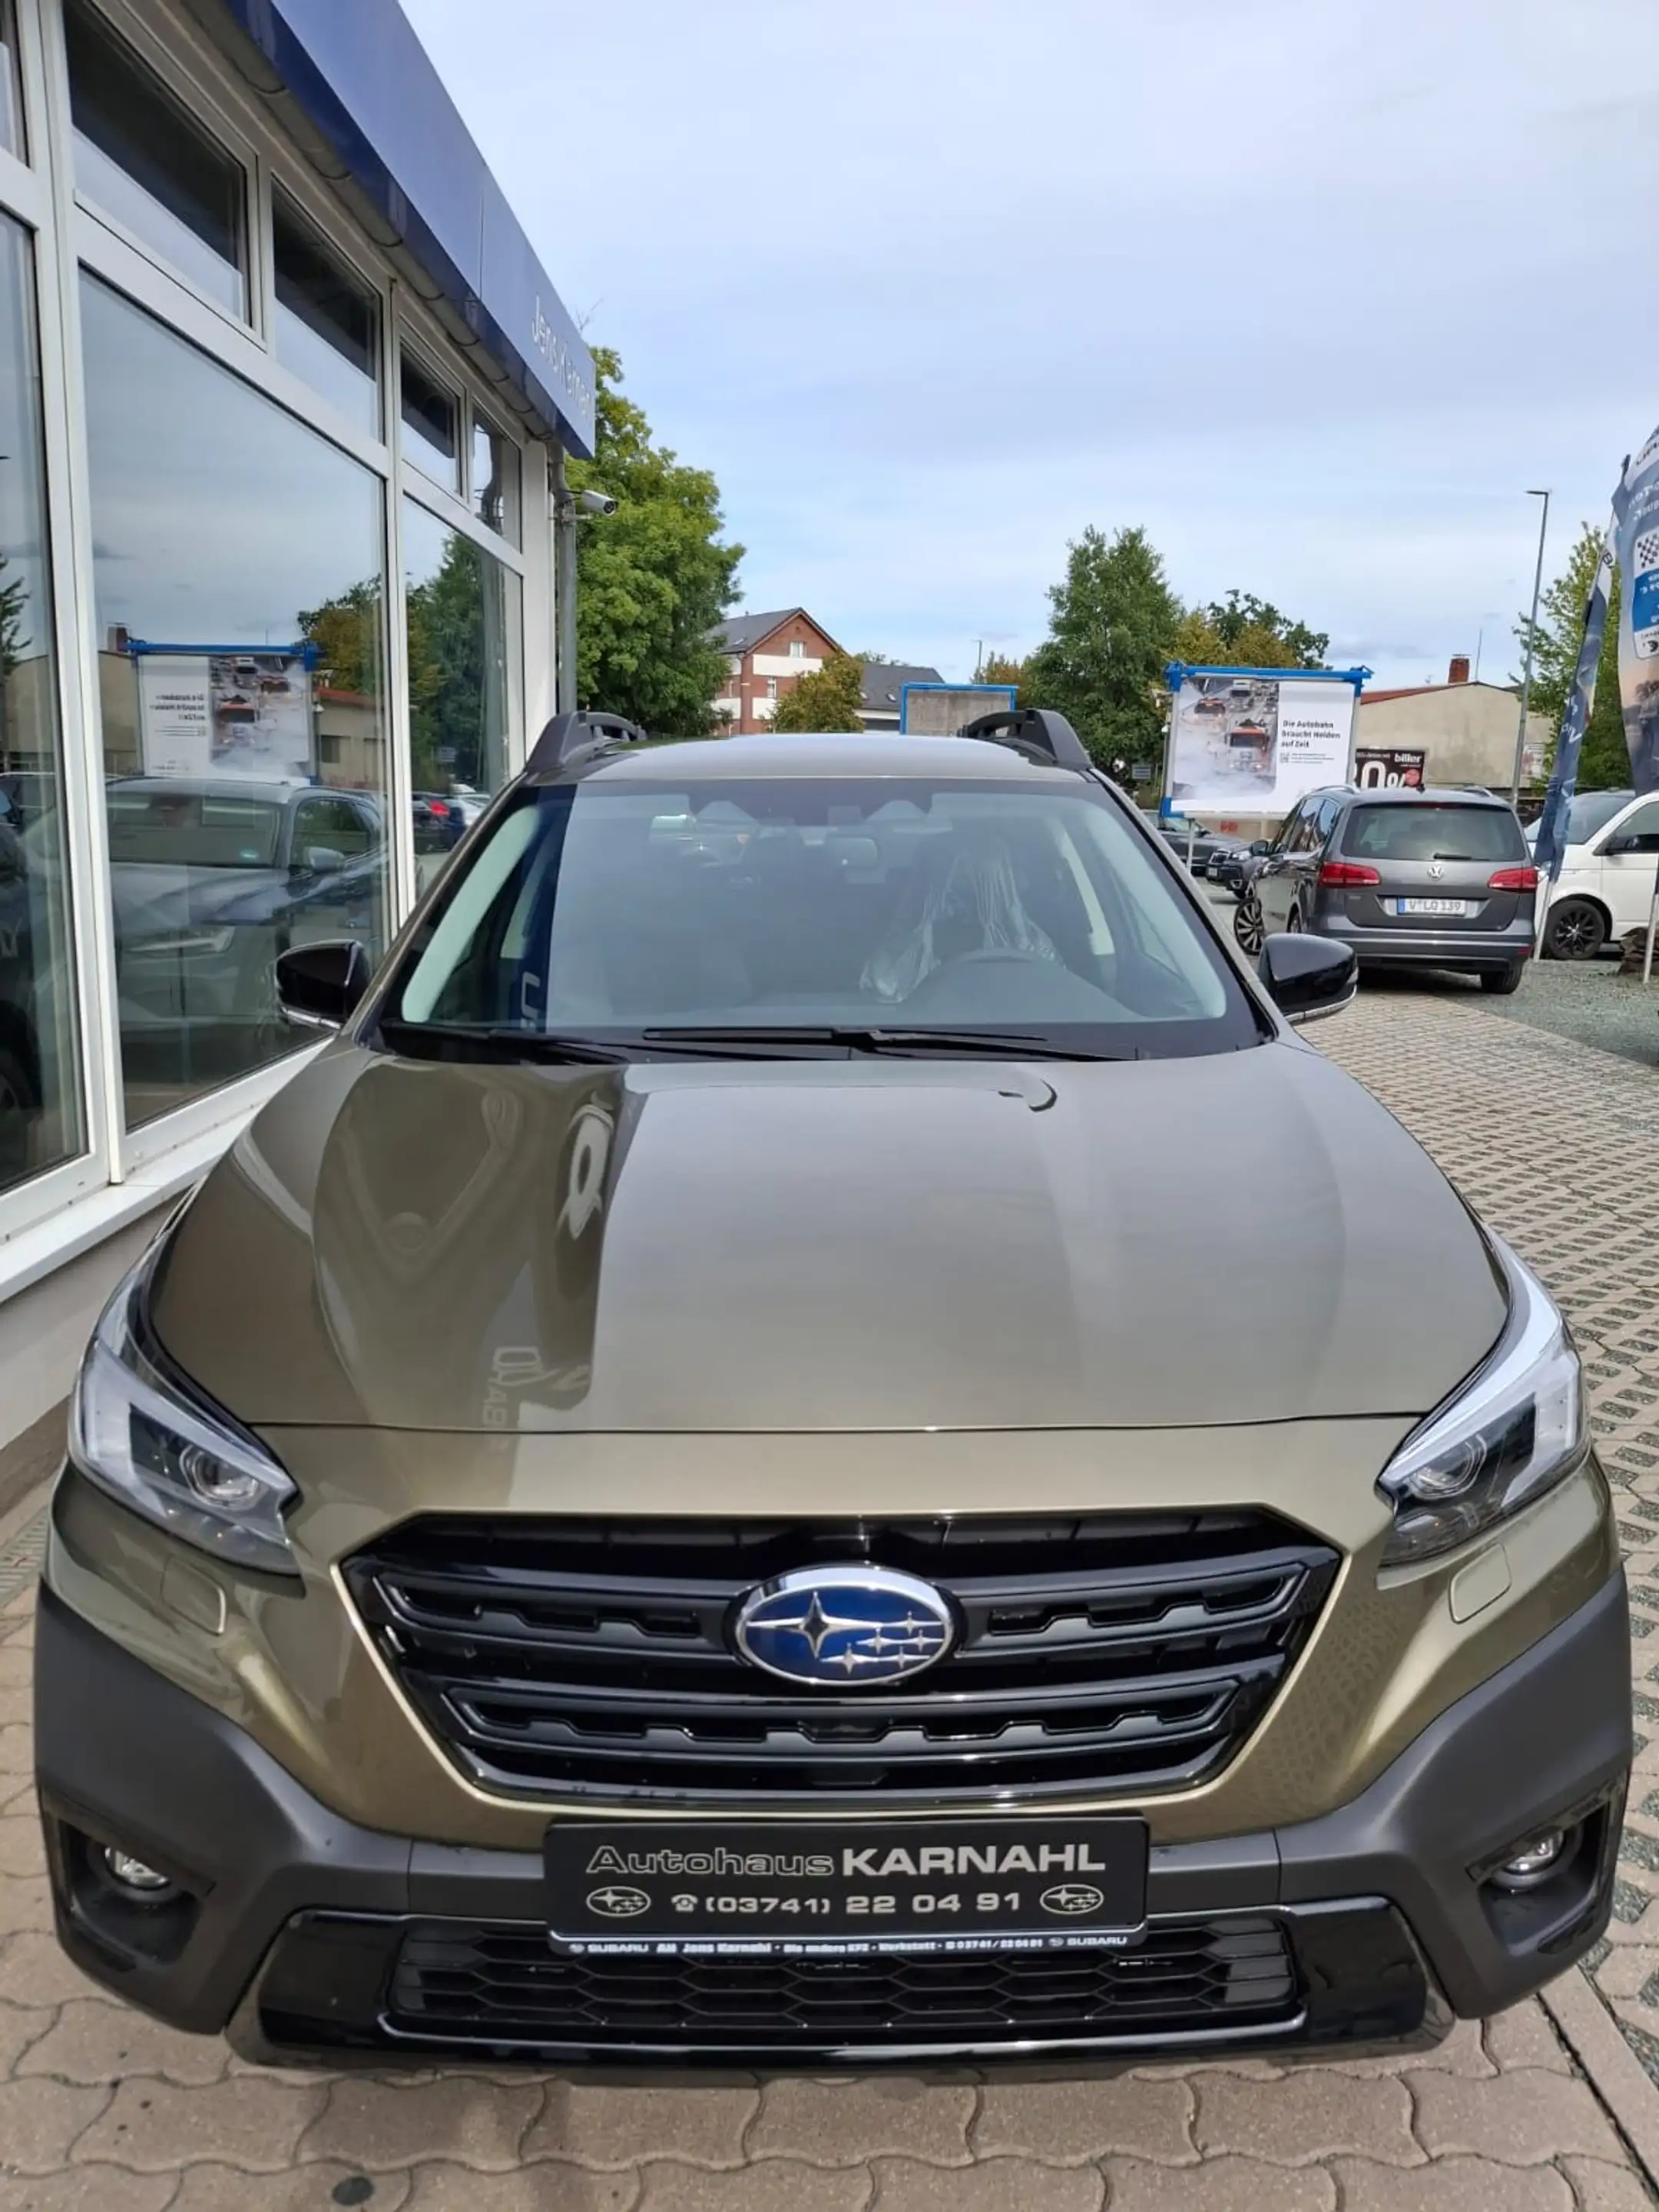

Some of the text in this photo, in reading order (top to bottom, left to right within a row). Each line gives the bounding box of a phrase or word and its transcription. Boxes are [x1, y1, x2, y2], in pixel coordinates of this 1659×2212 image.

[586, 1844, 1106, 1876] Autohaus KARNAHL
[705, 1892, 1020, 1914] (03741) 22 04 91
[587, 1942, 649, 1954] SUBARU
[1067, 1936, 1128, 1947] SUBARU
